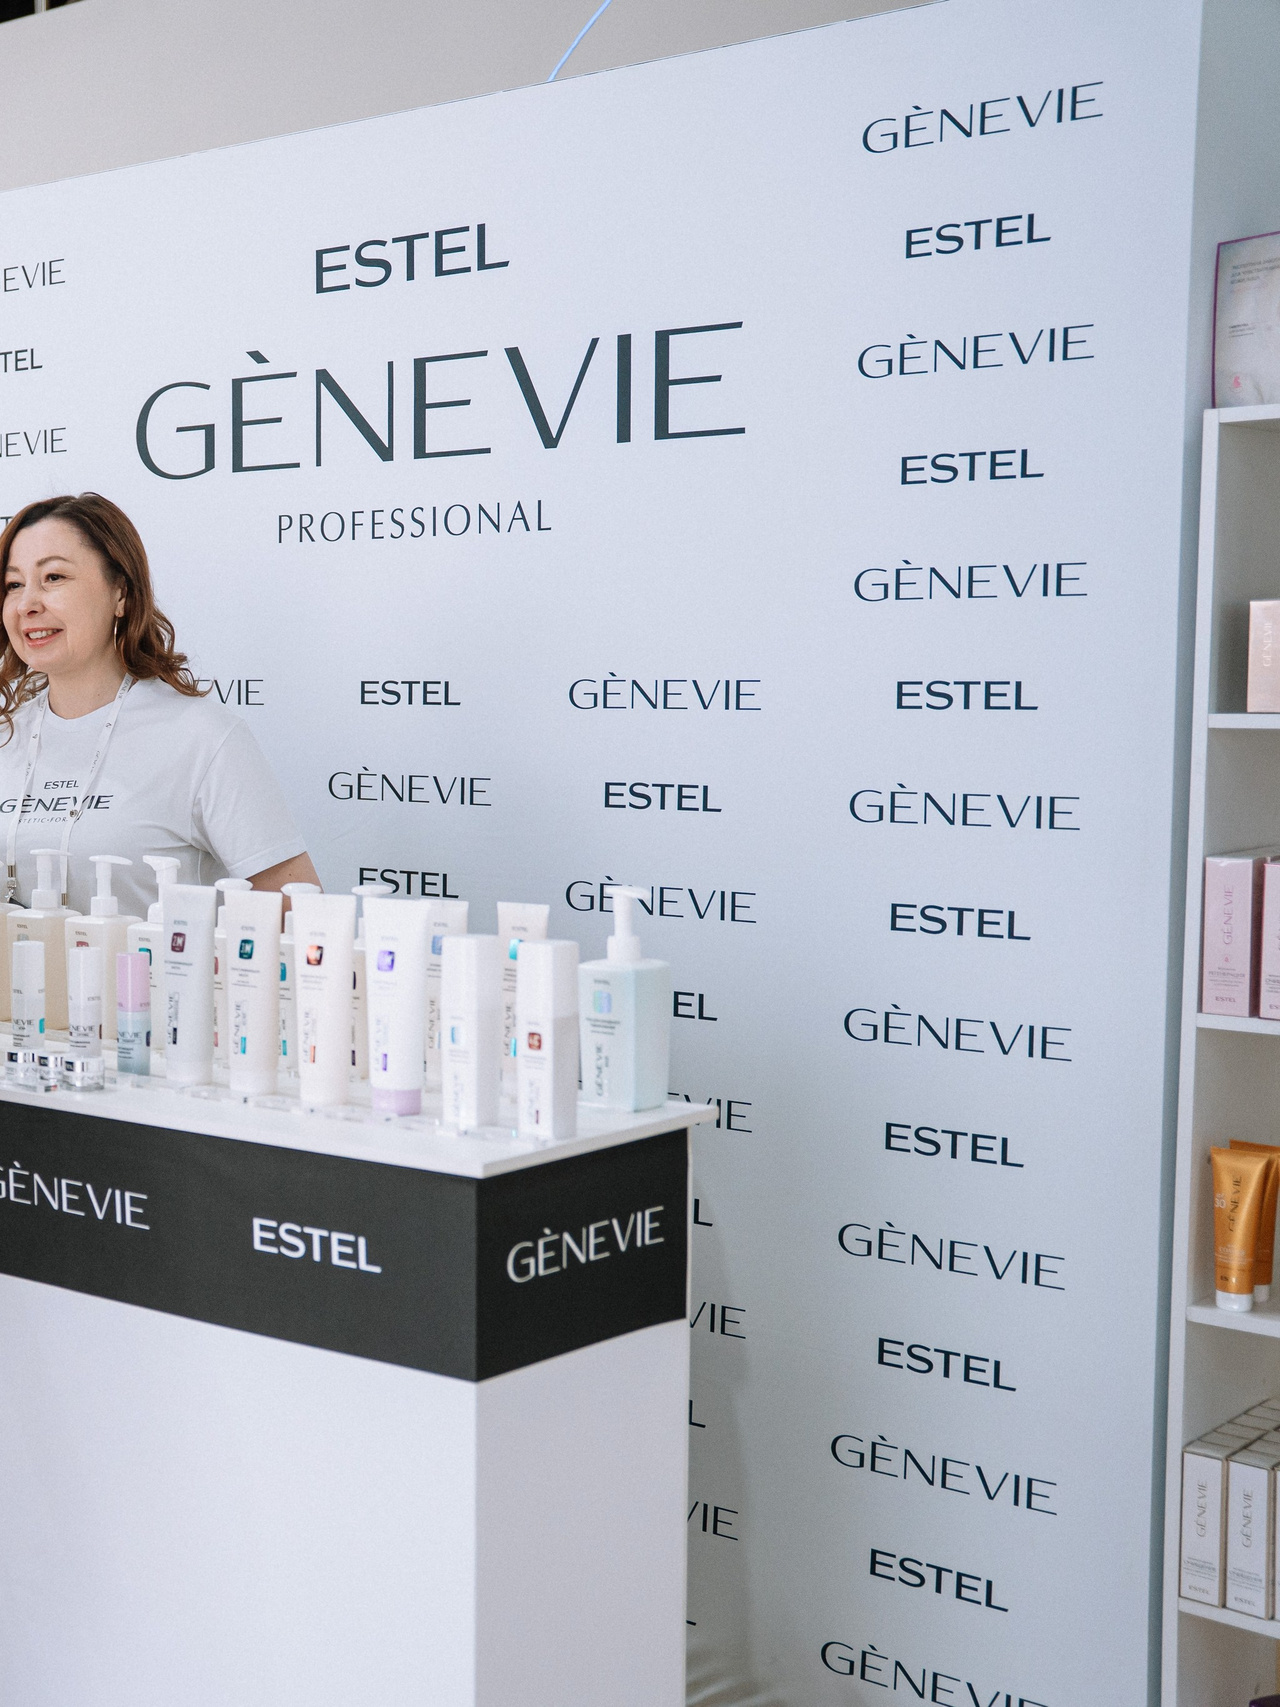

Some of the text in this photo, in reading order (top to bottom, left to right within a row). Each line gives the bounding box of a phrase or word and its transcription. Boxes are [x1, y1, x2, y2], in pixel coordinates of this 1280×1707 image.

[862, 81, 1104, 153] GÈNEVIE
[316, 223, 510, 294] ESTEL
[906, 213, 1051, 259] ESTEL
[858, 324, 1095, 378] GÈNEVIE
[136, 321, 746, 480] GÈNEVIE
[901, 449, 1045, 485] ESTEL
[278, 500, 552, 543] PROFESSIONAL
[854, 560, 1088, 602] GÈNEVIE
[361, 680, 461, 705] ESTEL
[569, 672, 762, 711] GÈNEVIE
[897, 680, 1038, 710] ESTEL
[43, 780, 79, 790] ESTEL
[329, 766, 492, 806] GÈNEVIE
[605, 782, 722, 812] ESTEL
[849, 783, 1080, 830] GÈNEVIE
[359, 867, 459, 899] ESTEL
[565, 876, 756, 923] GÈNEVIE
[891, 903, 1031, 940] ESTEL
[844, 1004, 1072, 1062] GÈNEVIE
[885, 1122, 1024, 1168] ESTEL
[253, 1217, 382, 1273] ESTEL
[507, 1206, 665, 1283] GÈNEVIE
[838, 1221, 1065, 1290] GÈNEVIE
[878, 1337, 1017, 1392] ESTEL
[831, 1435, 1057, 1515] GÈNEVIE
[869, 1548, 1008, 1613] ESTEL
